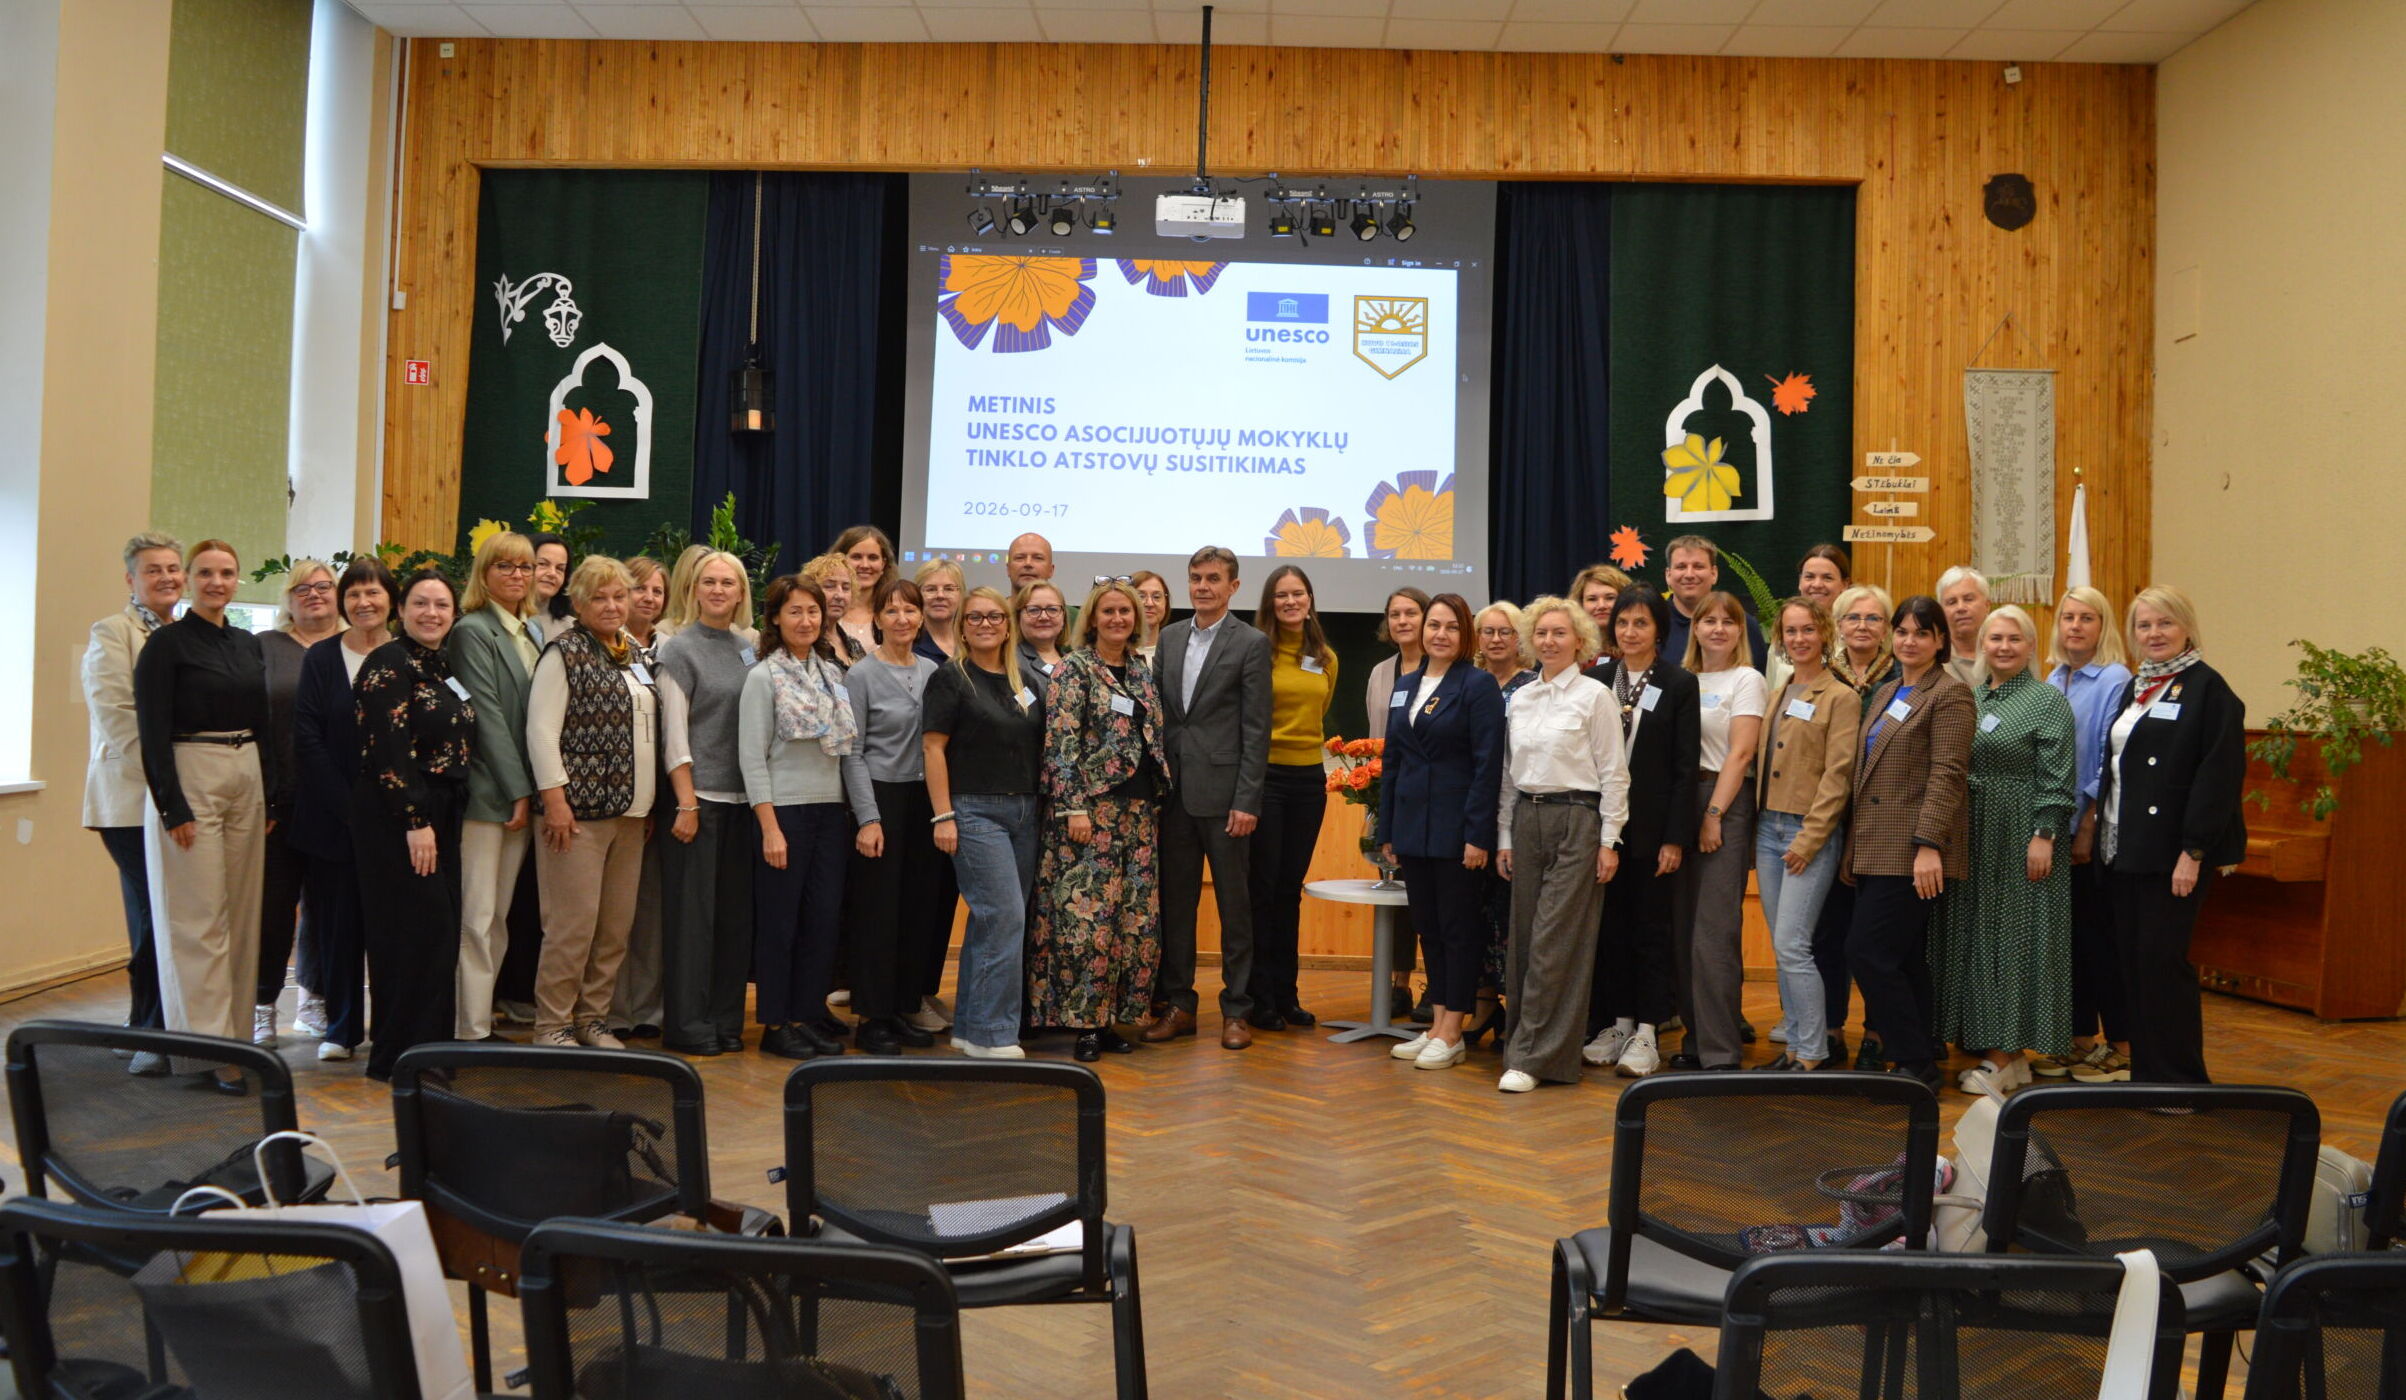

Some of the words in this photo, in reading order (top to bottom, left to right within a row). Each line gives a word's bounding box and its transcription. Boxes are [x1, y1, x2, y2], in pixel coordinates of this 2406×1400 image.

[1401, 259, 1414, 267] Sign
[1246, 327, 1330, 345] unesco
[968, 395, 1056, 415] METINIS
[967, 422, 1058, 442] UNESCO
[1064, 425, 1231, 452] ASOCIJUOTŲJŲ
[1238, 429, 1349, 455] MOKYKLŲ
[966, 448, 1047, 468] TINKLO
[1054, 451, 1158, 477] ATSTOVŲ
[1166, 454, 1307, 475] SUSITIKIMAS
[963, 501, 1069, 518] 2026-09-17
